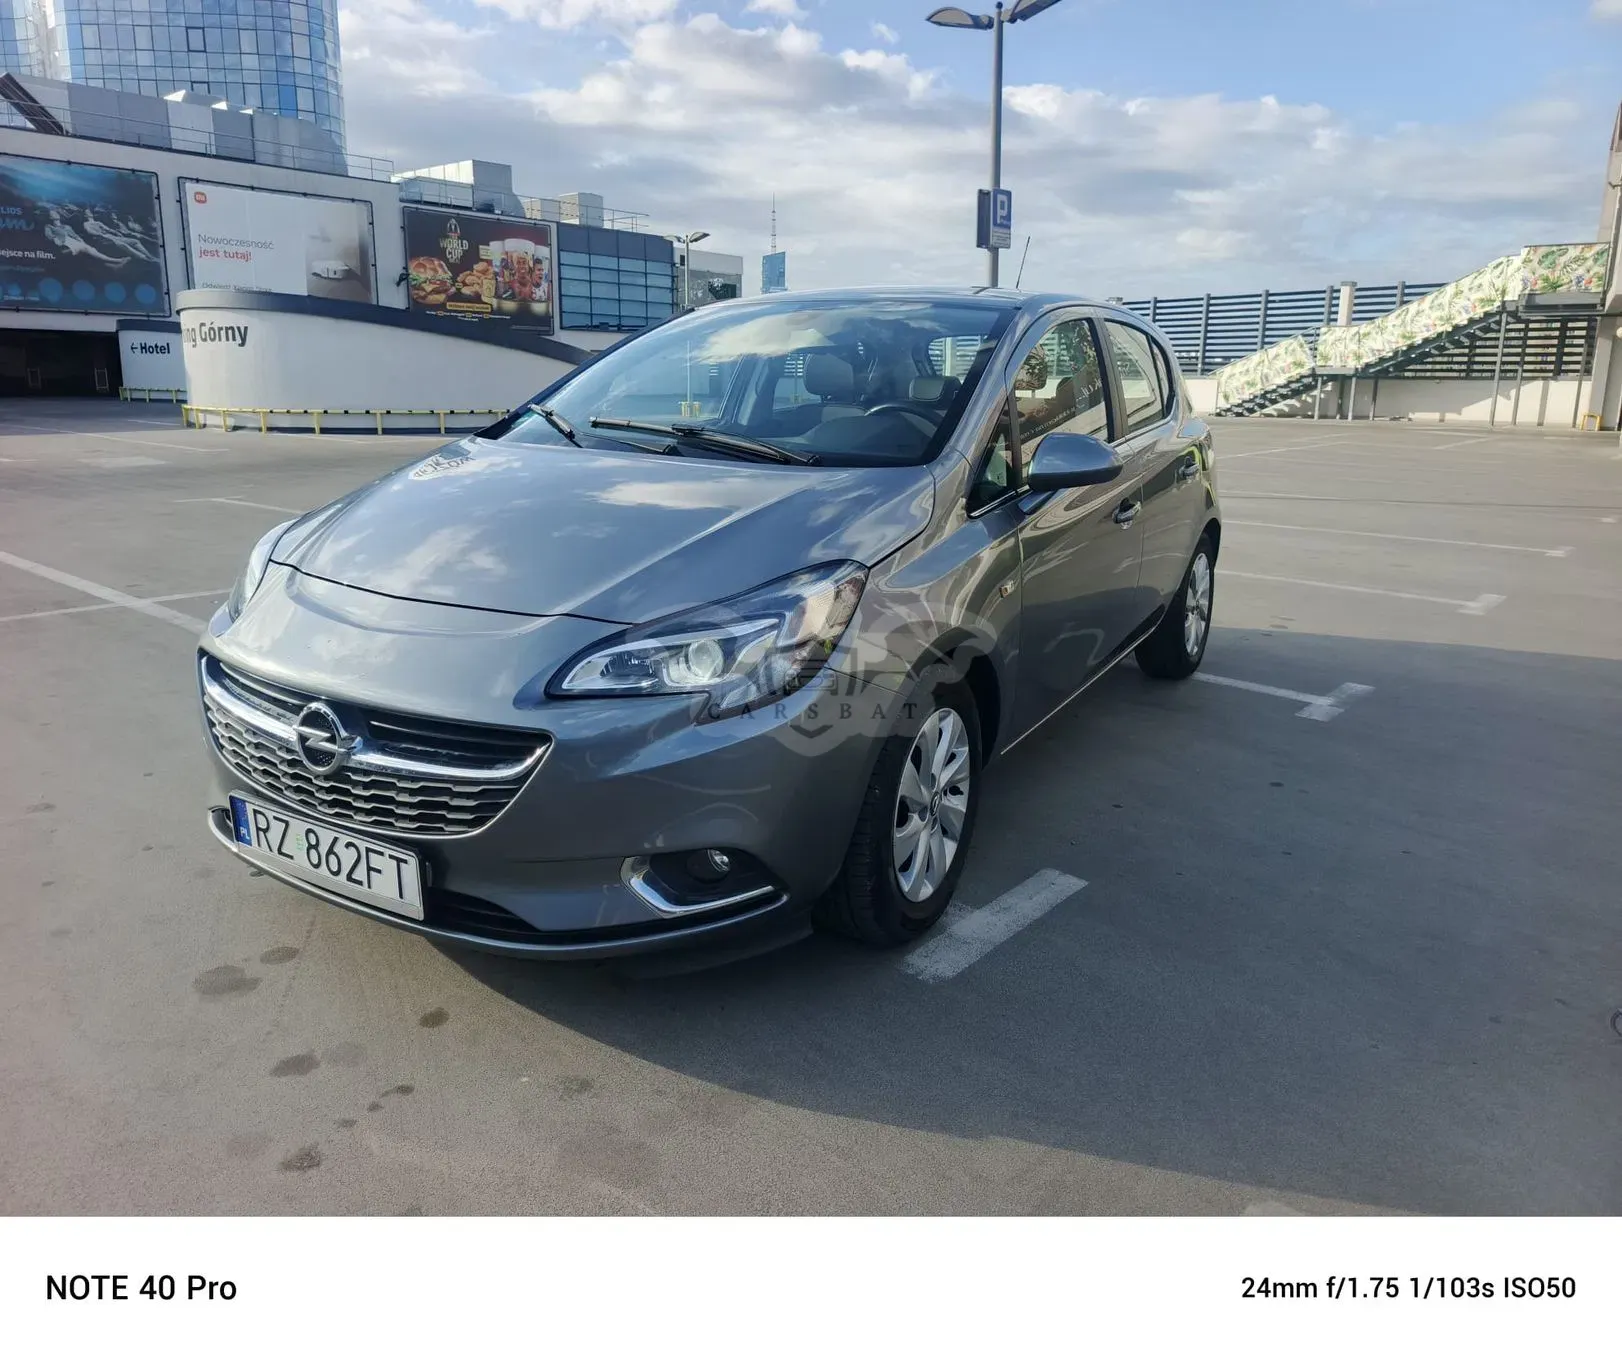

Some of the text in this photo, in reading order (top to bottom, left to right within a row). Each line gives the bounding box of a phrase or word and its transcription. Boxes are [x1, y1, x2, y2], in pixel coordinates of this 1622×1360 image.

[997, 194, 1008, 224] P
[198, 234, 275, 250] Nowoczesność
[440, 239, 469, 250] WORLD
[36, 250, 56, 260] film.
[199, 247, 252, 262] jest tutaj!
[446, 248, 463, 259] CUP
[199, 320, 249, 348] Górny
[140, 342, 171, 355] Hotel
[240, 826, 250, 840] PL
[252, 808, 408, 900] RZ 862FT
